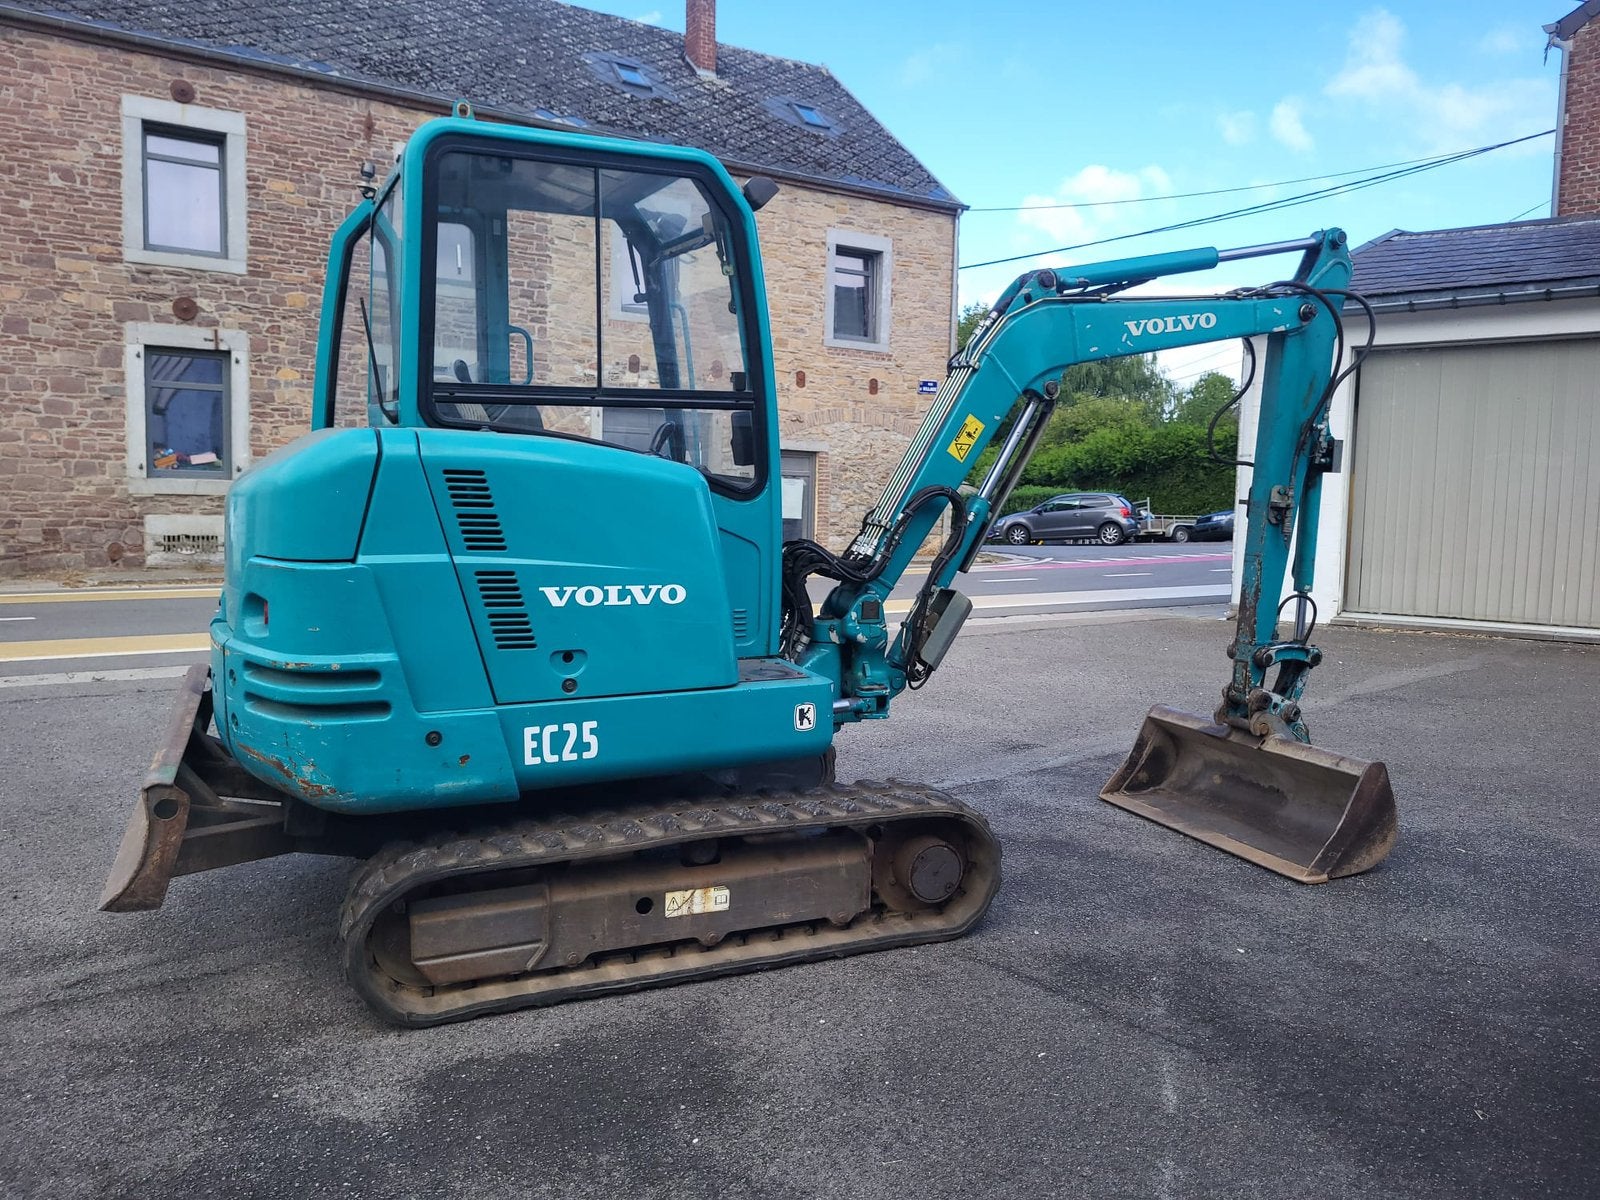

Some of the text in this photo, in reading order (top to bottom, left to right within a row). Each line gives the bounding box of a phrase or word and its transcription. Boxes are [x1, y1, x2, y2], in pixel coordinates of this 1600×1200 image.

[1123, 312, 1217, 336] VOLVO
[538, 584, 687, 607] VOLVO
[524, 720, 599, 766] EC25
